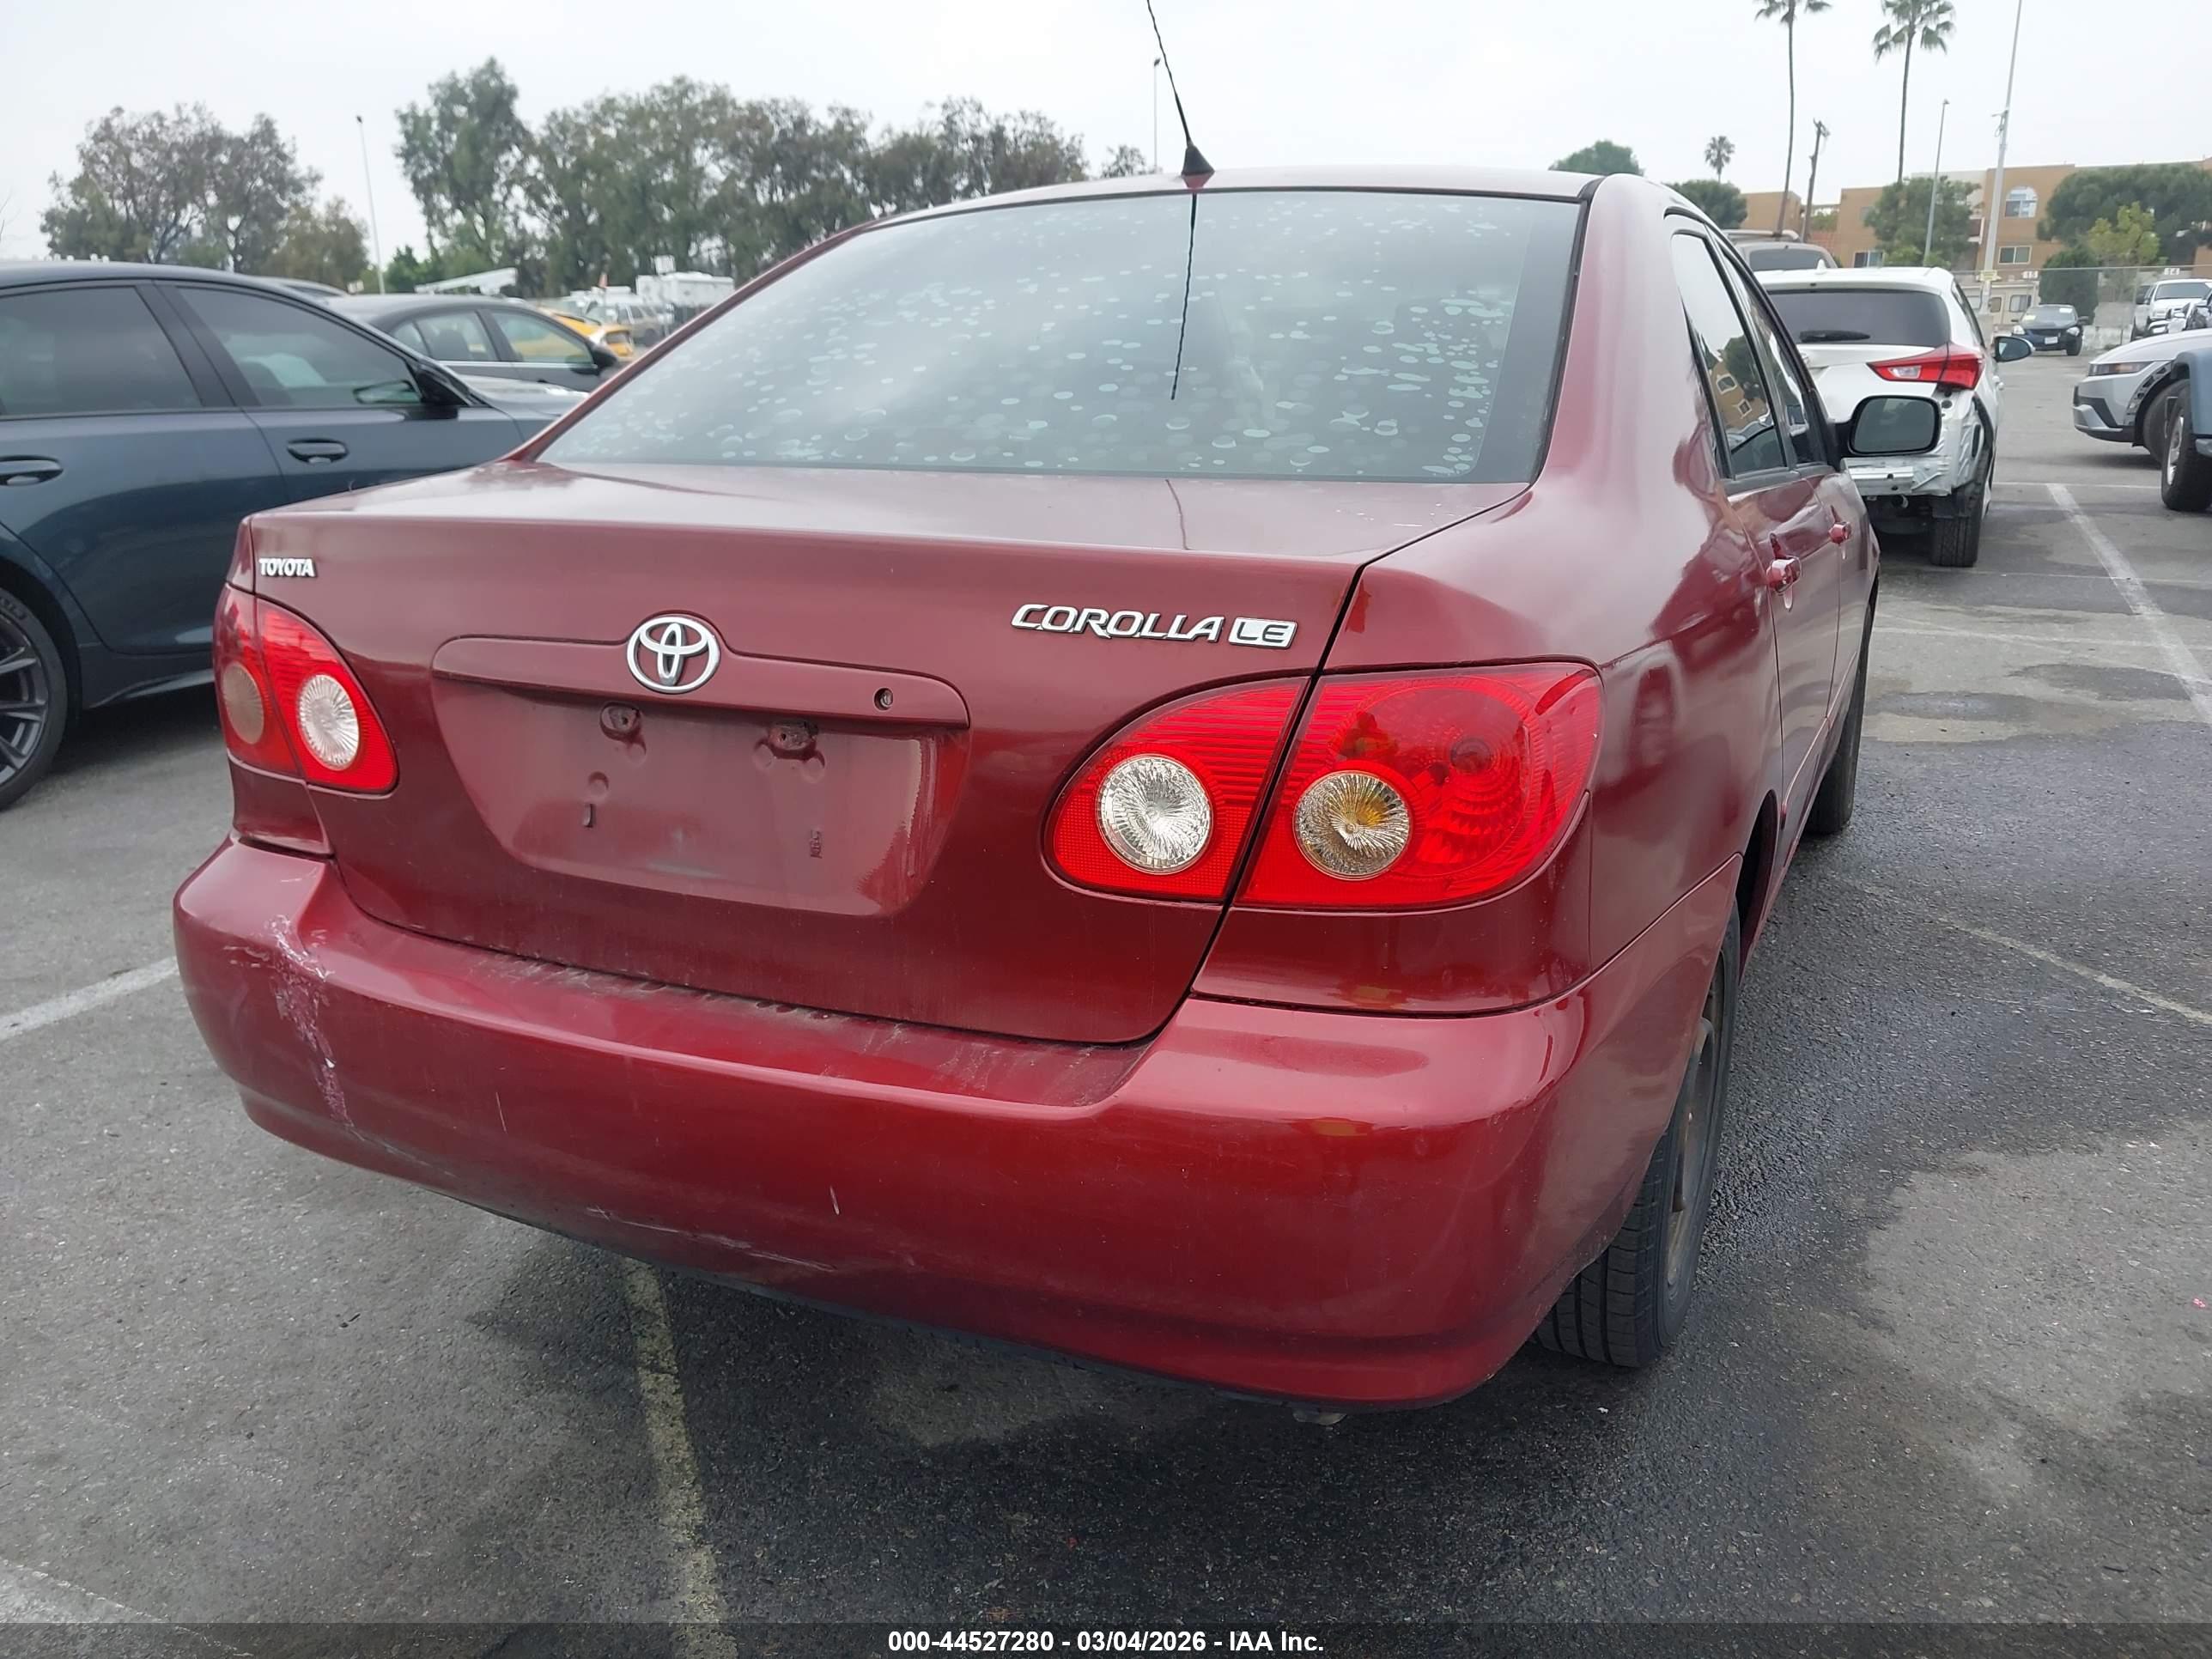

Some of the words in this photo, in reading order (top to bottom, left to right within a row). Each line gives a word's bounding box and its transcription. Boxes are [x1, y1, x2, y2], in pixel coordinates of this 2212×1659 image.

[258, 558, 315, 577] TOYOTA
[1011, 604, 1224, 642] COROLLA
[1234, 620, 1291, 645] LE
